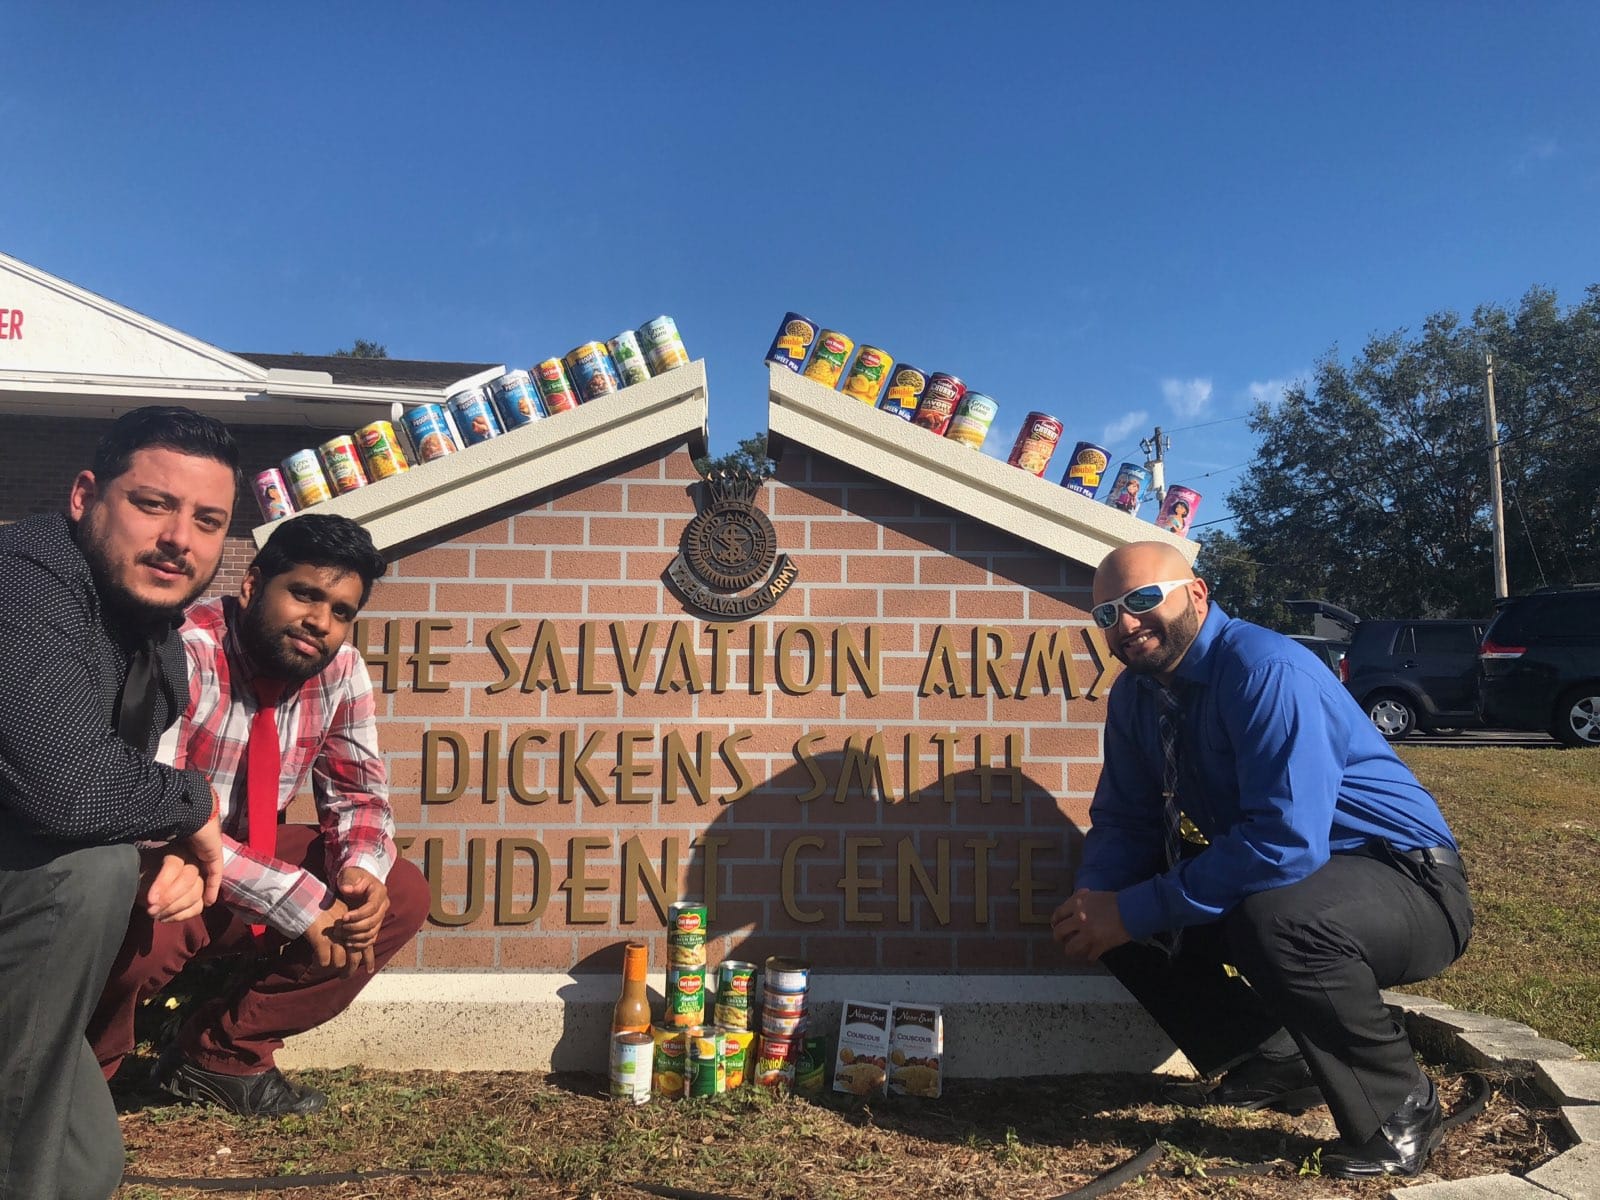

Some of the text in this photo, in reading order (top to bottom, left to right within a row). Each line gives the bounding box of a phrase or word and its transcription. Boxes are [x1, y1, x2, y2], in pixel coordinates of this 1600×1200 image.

[972, 400, 991, 411] Green
[1067, 483, 1084, 493] SWEET
[701, 512, 765, 562] BLOOD AND FIRE
[672, 561, 798, 613] THE SALVATION ARMY
[353, 618, 1120, 701] HE SALVATION ARMY
[421, 729, 1023, 806] DICKENS SMITH
[393, 834, 1066, 927] UDENT CENTE
